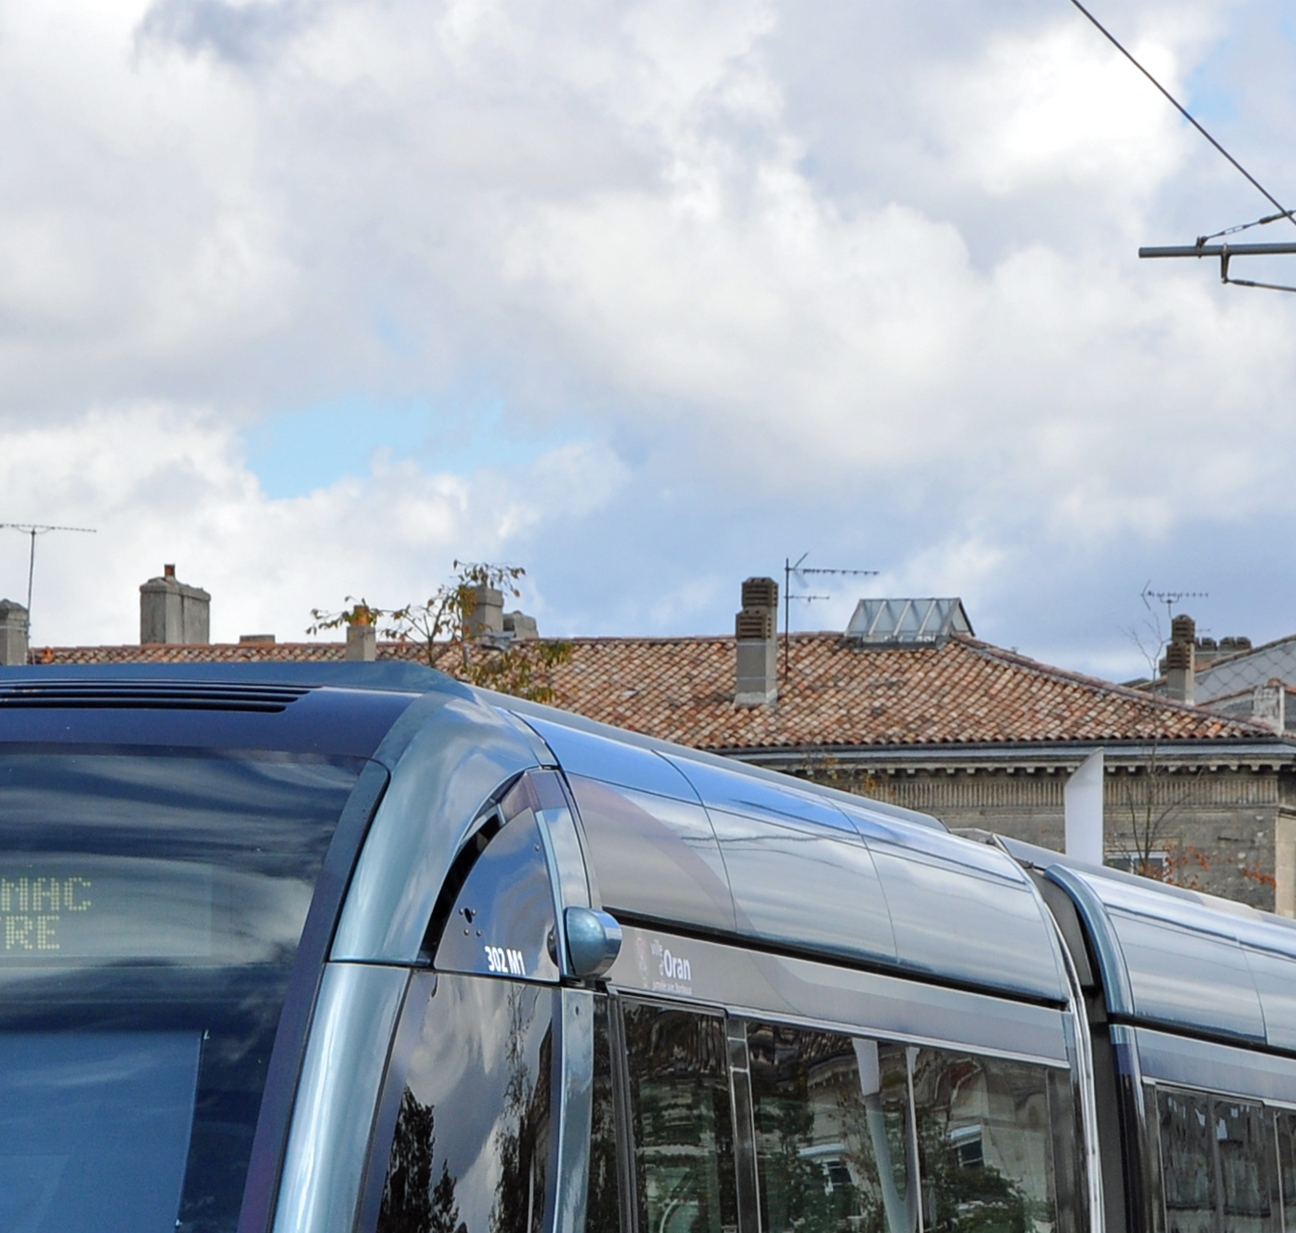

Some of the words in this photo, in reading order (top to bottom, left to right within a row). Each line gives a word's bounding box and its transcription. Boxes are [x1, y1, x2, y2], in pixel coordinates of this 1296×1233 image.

[484, 945, 509, 973] 302
[506, 948, 527, 976] M1
[663, 948, 692, 981] Oran
